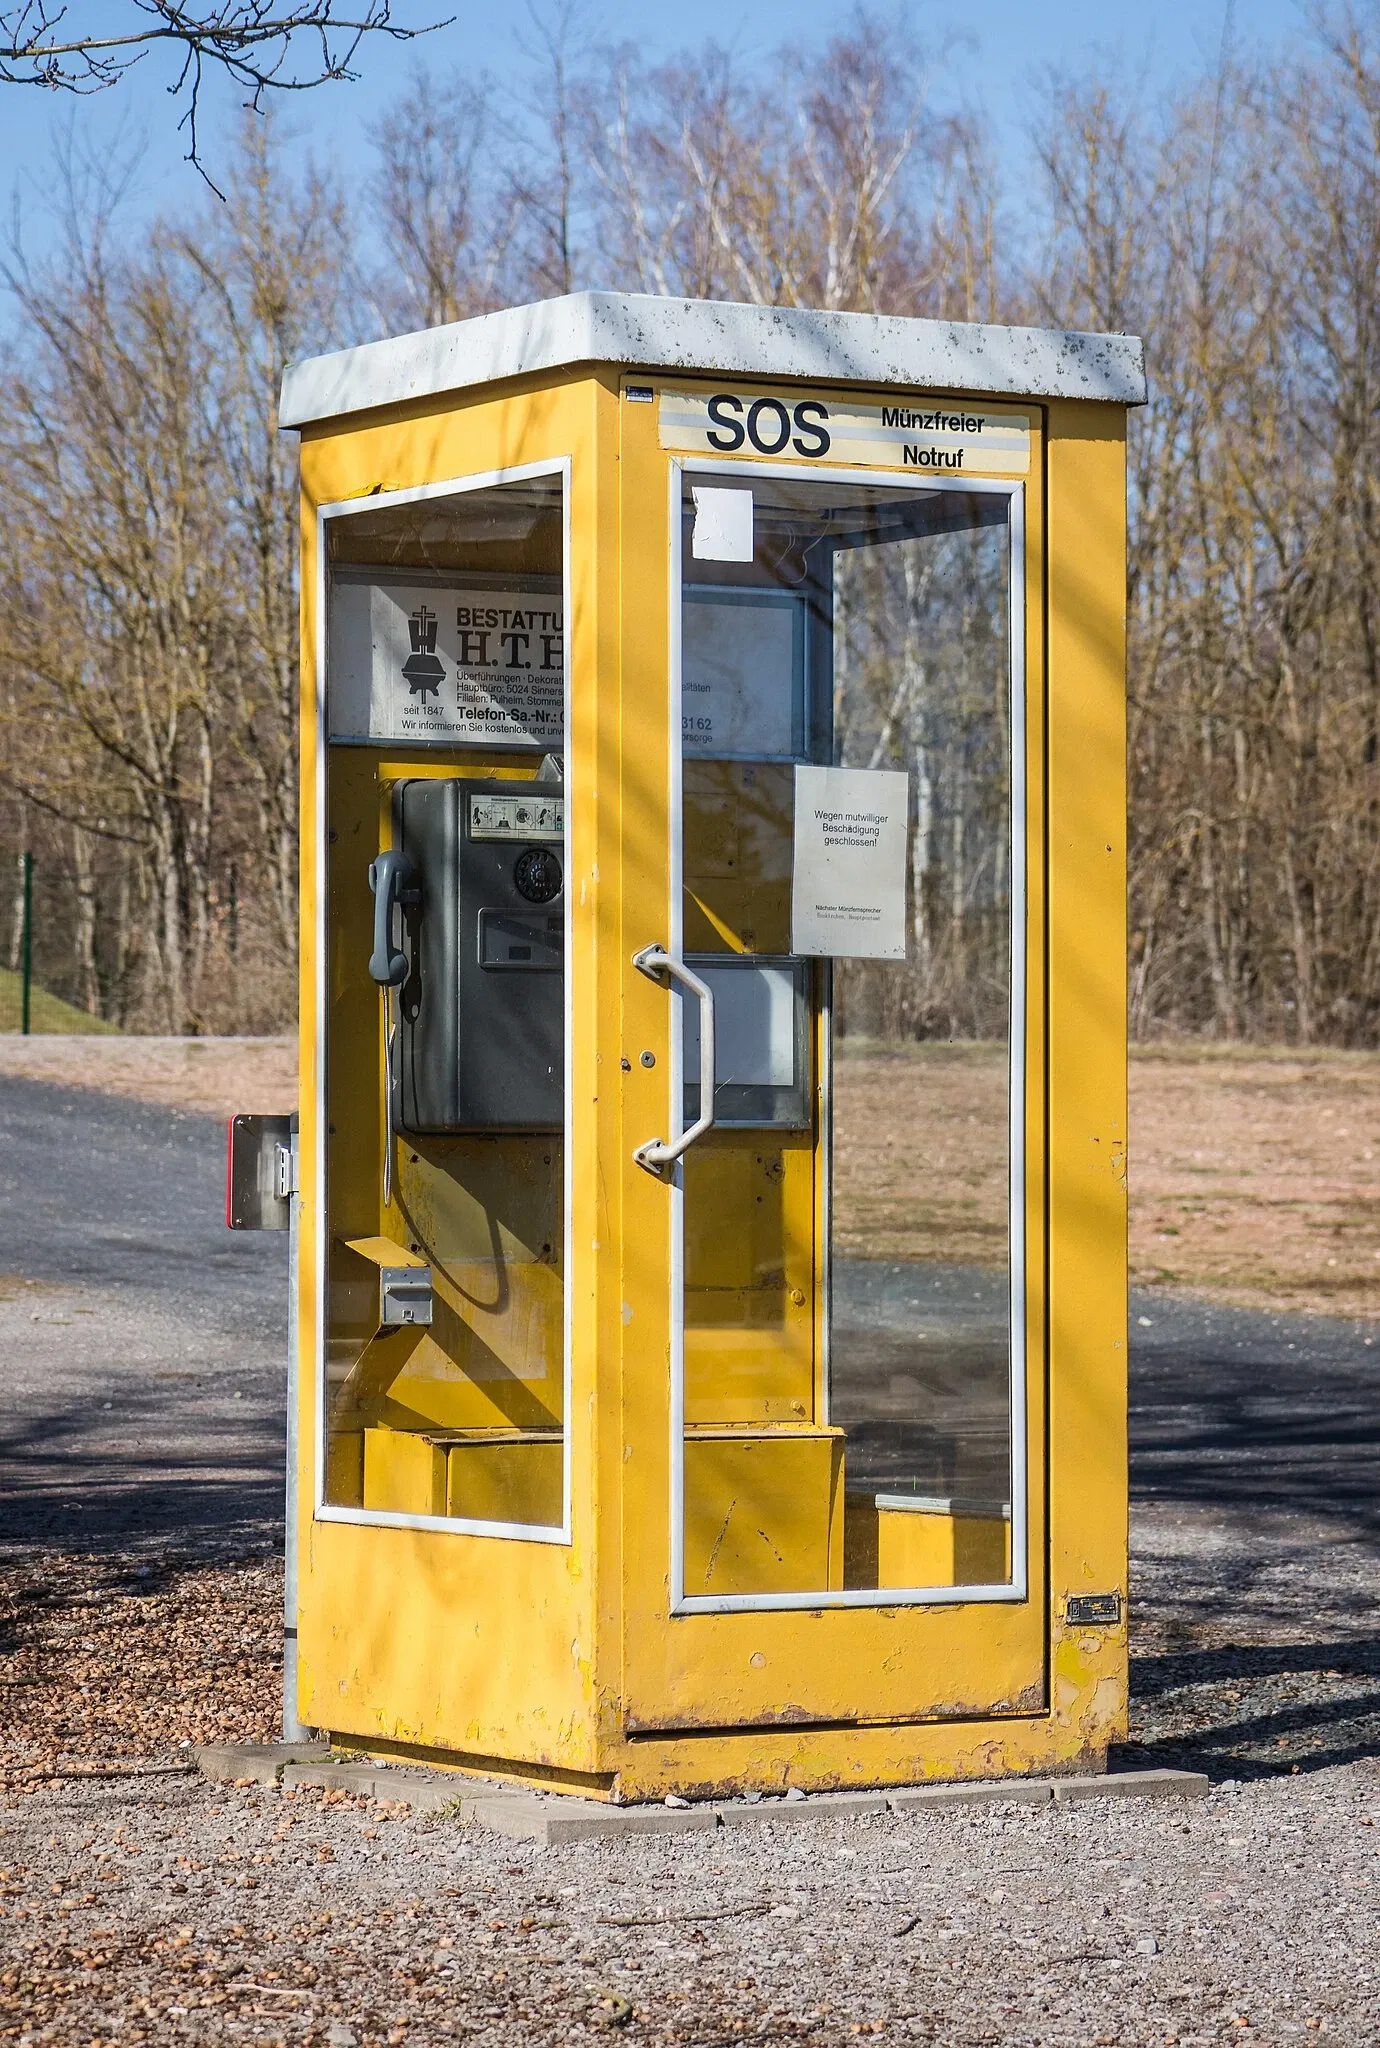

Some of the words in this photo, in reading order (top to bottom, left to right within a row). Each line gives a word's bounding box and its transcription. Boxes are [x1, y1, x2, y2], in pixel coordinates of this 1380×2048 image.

[706, 394, 831, 457] SOS
[882, 407, 985, 433] Münzfreier
[903, 445, 964, 468] Notruf
[456, 607, 564, 632] BESTATTU
[456, 670, 521, 684] Überführungen
[456, 683, 505, 696] Hauptbüro:
[506, 685, 529, 694] 5024
[456, 693, 489, 704] Filialen:
[403, 705, 420, 715] seit
[422, 706, 445, 716] 1847
[456, 706, 557, 723] Telefon-Sa.-Nr.:
[401, 720, 417, 729] Wir
[418, 720, 467, 731] informieren
[468, 722, 483, 732] Sie
[484, 723, 527, 734] kostenlos
[529, 726, 546, 735] und
[814, 810, 843, 822] Wegen
[845, 812, 889, 825] mutwilliger
[822, 823, 880, 837] Beschädigung
[824, 837, 877, 847] geschlossen!
